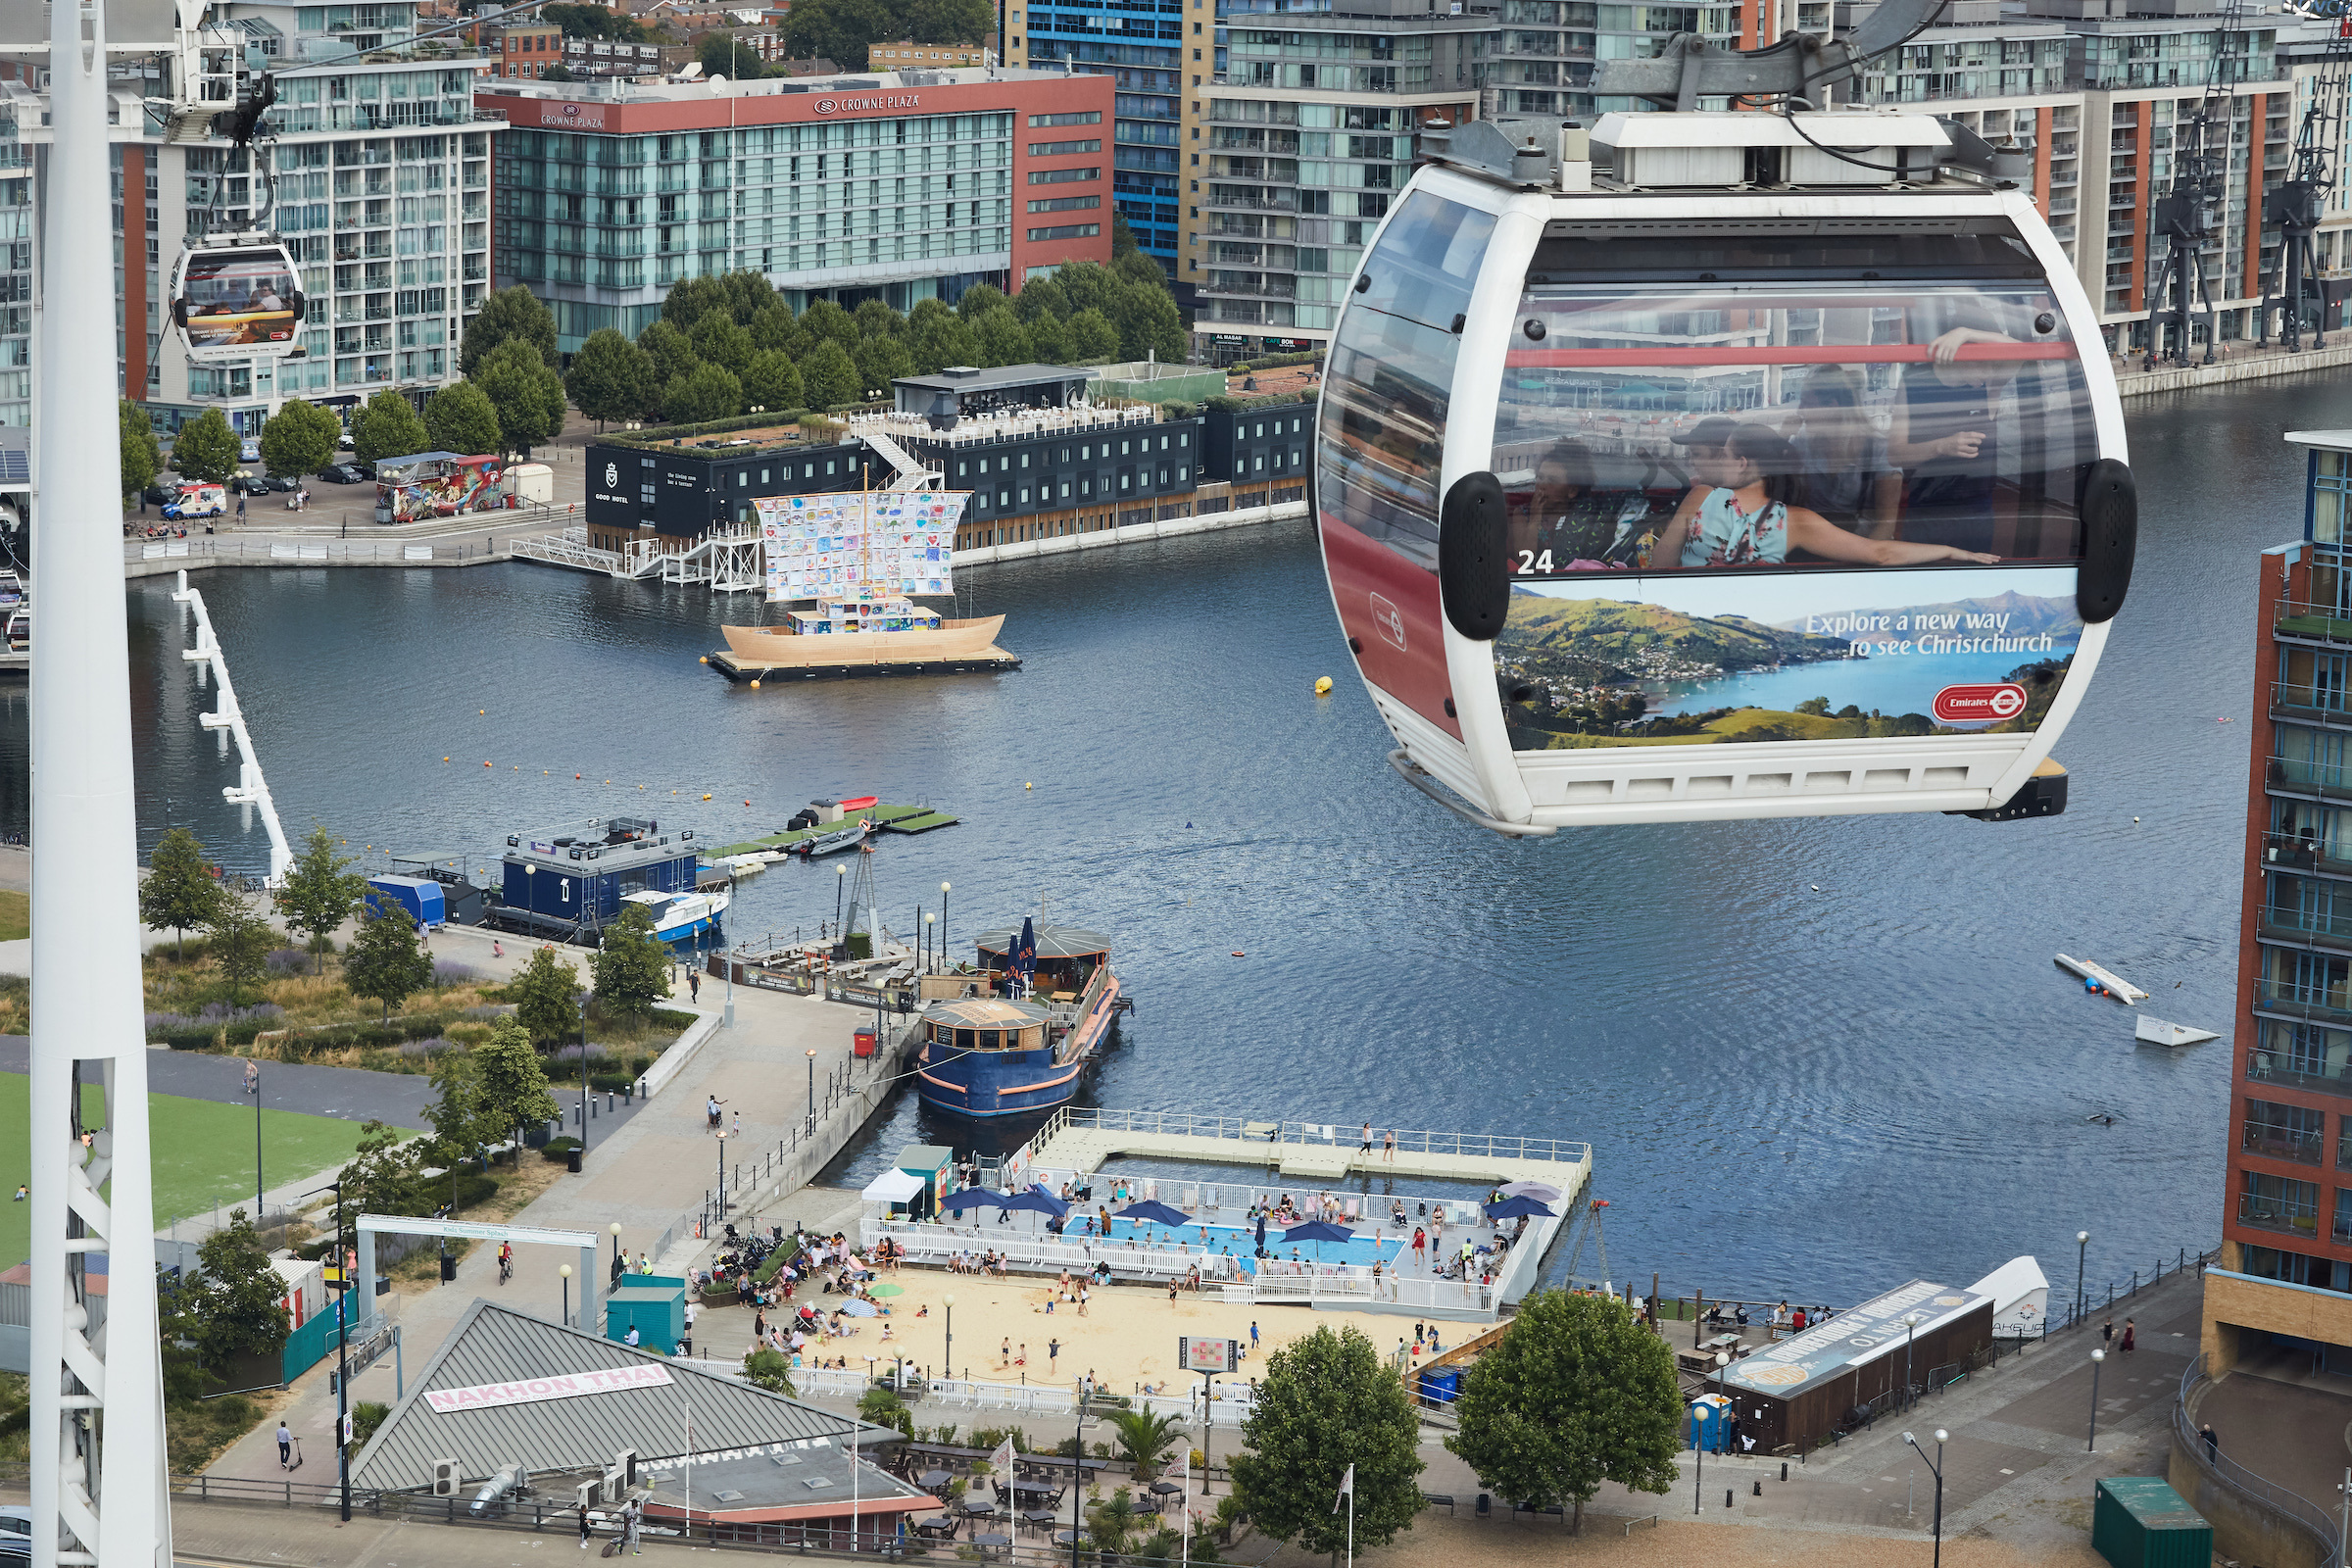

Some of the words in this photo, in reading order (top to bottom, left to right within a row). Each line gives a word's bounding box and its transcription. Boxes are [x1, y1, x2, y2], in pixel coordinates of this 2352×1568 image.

[842, 97, 883, 111] CROWNE
[888, 95, 918, 108] PLAZA
[541, 115, 573, 125] CROWNE
[578, 118, 603, 128] PLAZA
[612, 495, 628, 504] HOTEL
[1518, 549, 1554, 574] 24
[1806, 612, 1890, 637] Explore
[1896, 615, 1908, 630] a
[1915, 614, 1960, 630] new
[1966, 612, 2010, 633] way
[1849, 638, 1871, 657] to
[1877, 639, 1910, 656] see
[1917, 632, 2052, 655] Christchurch
[1950, 697, 1988, 707] Emirates
[1002, 1054, 1026, 1064] OILER
[1849, 1334, 1886, 1348] TO
[429, 1377, 579, 1406] NAKHON
[583, 1366, 666, 1386] THAI
[439, 1398, 503, 1412] AUTHENTIC
[500, 1396, 531, 1404] THAI
[531, 1390, 576, 1400] CUISINE
[590, 1381, 645, 1394] COCKTAIL
